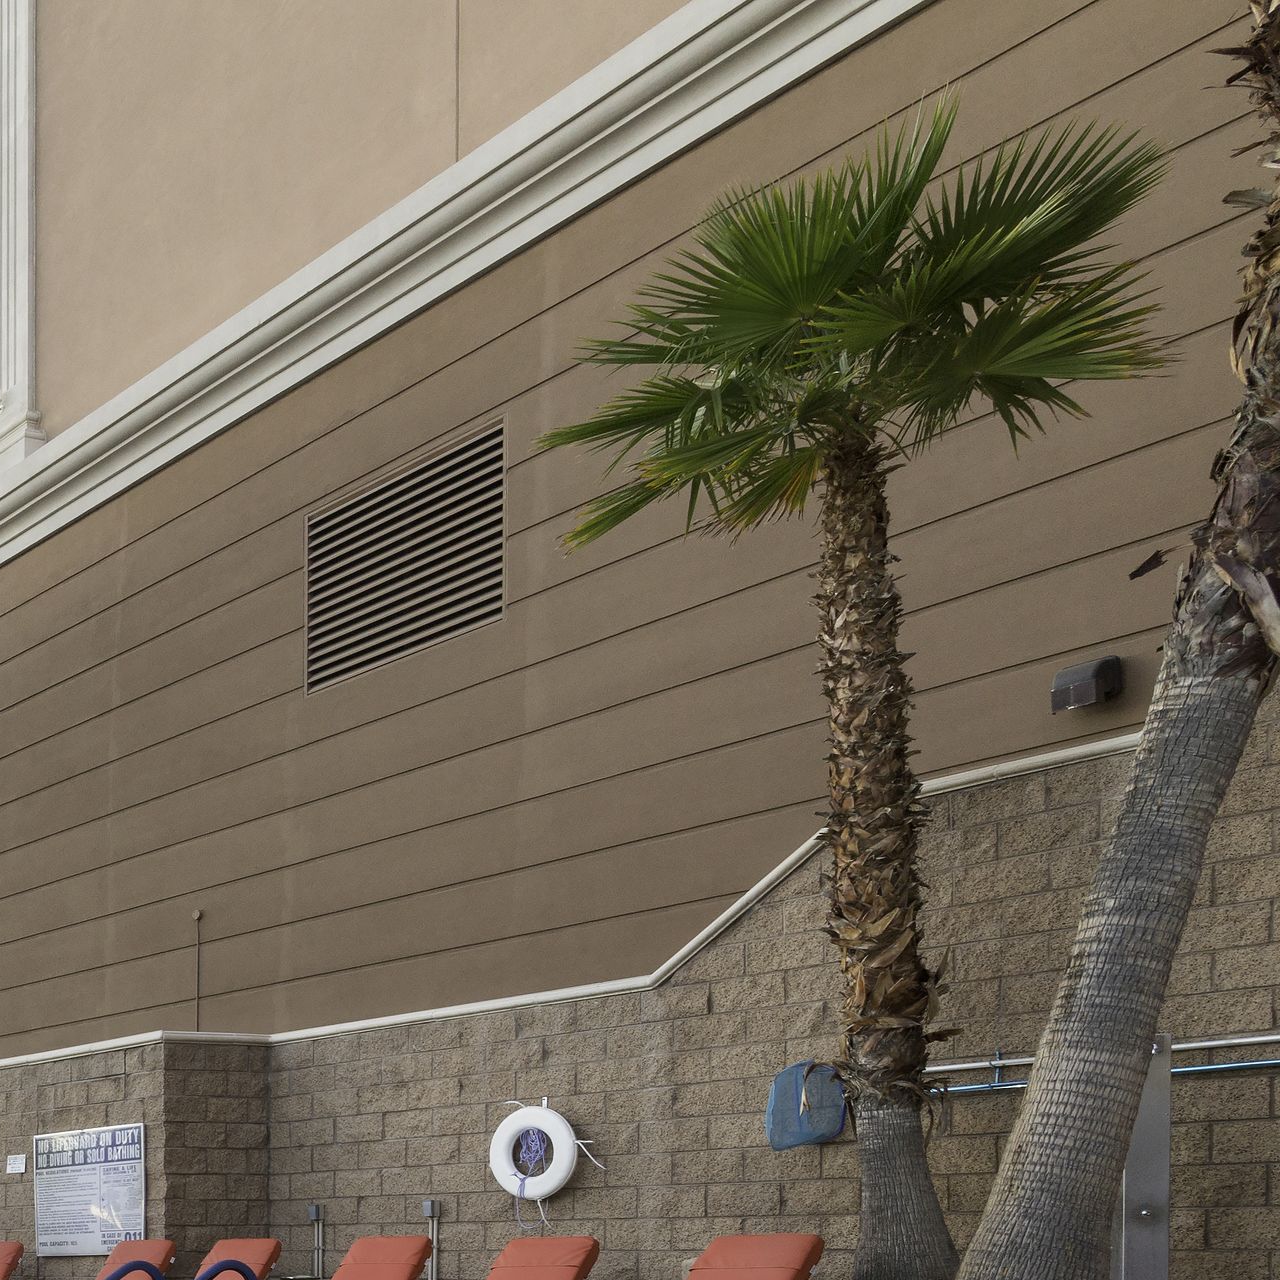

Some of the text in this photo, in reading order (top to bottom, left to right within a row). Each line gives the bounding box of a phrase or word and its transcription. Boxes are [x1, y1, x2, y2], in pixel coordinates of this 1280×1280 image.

[37, 1128, 139, 1154] NO LIFEGUARD ON DUTY
[37, 1154, 48, 1169] NO
[49, 1150, 73, 1167] DIVING
[74, 1149, 85, 1164] OR
[86, 1146, 105, 1163] SOLO
[107, 1144, 140, 1161] BATHING
